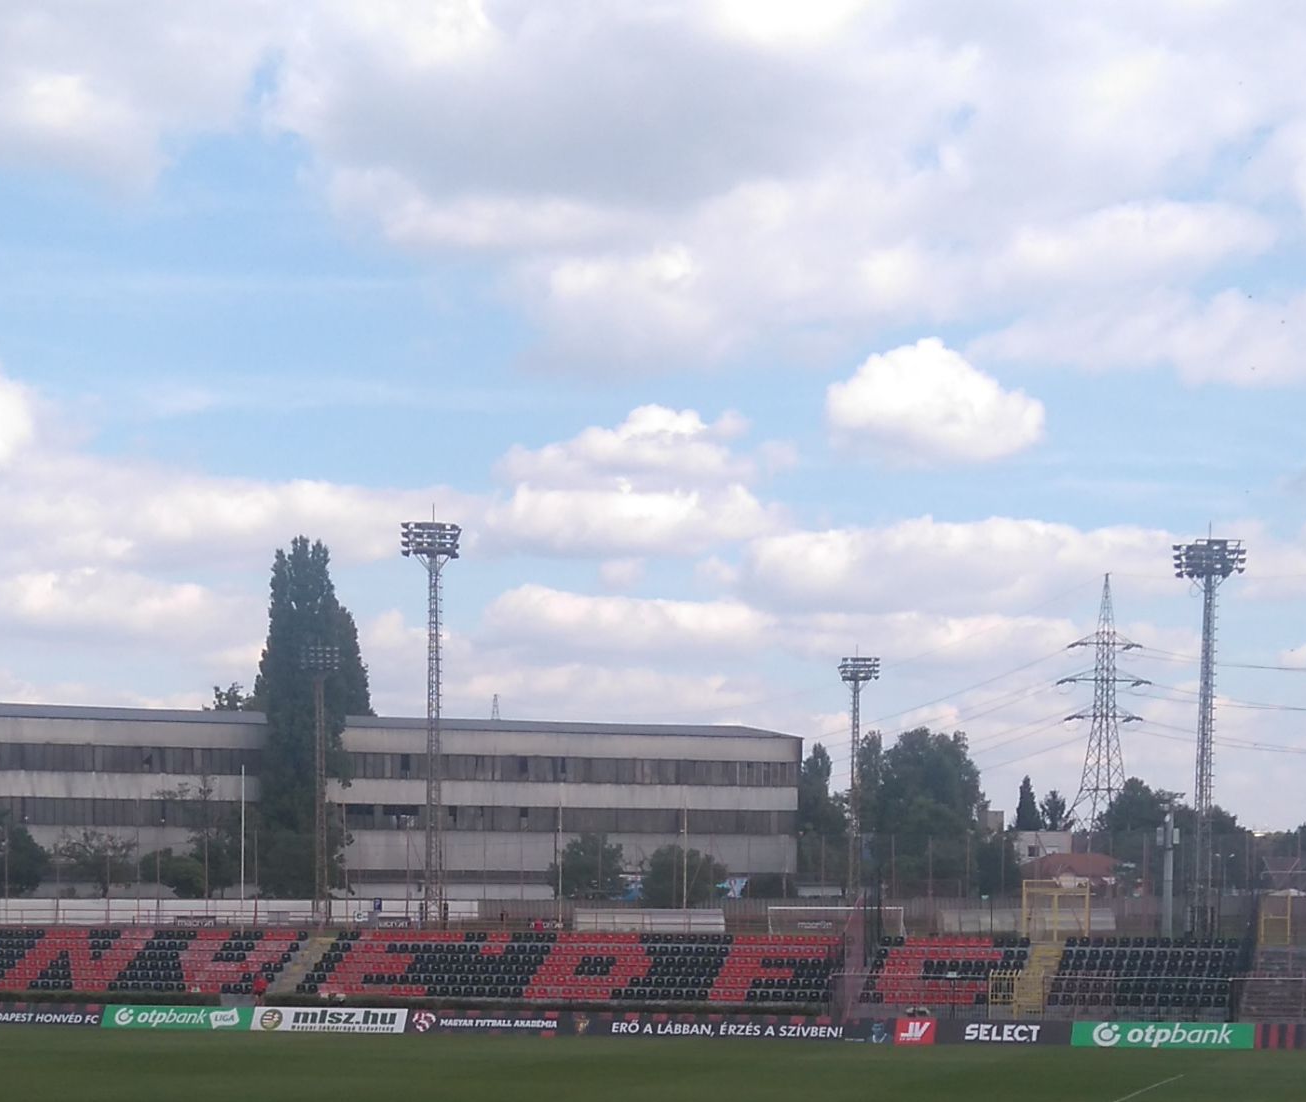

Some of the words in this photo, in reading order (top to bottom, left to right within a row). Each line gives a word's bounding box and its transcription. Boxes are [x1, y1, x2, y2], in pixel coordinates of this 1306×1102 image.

[36, 1012, 82, 1024] HONVÉD
[85, 1014, 99, 1024] FC
[137, 1009, 207, 1027] otpbank
[214, 1013, 235, 1022] LIGA
[293, 1010, 397, 1025] mlsz.hu
[440, 1019, 473, 1028] MAGYAR
[474, 1018, 512, 1028] FUTBALL
[611, 1020, 639, 1033] ERŐ
[643, 1023, 653, 1034] A
[657, 1021, 715, 1037] LÁBBAN,
[719, 1022, 761, 1036] ÉRZÉS
[764, 1025, 775, 1036] A
[779, 1023, 843, 1038] SZÍVBEN!
[964, 1023, 1041, 1042] SELECT
[1127, 1023, 1234, 1048] otpbank
